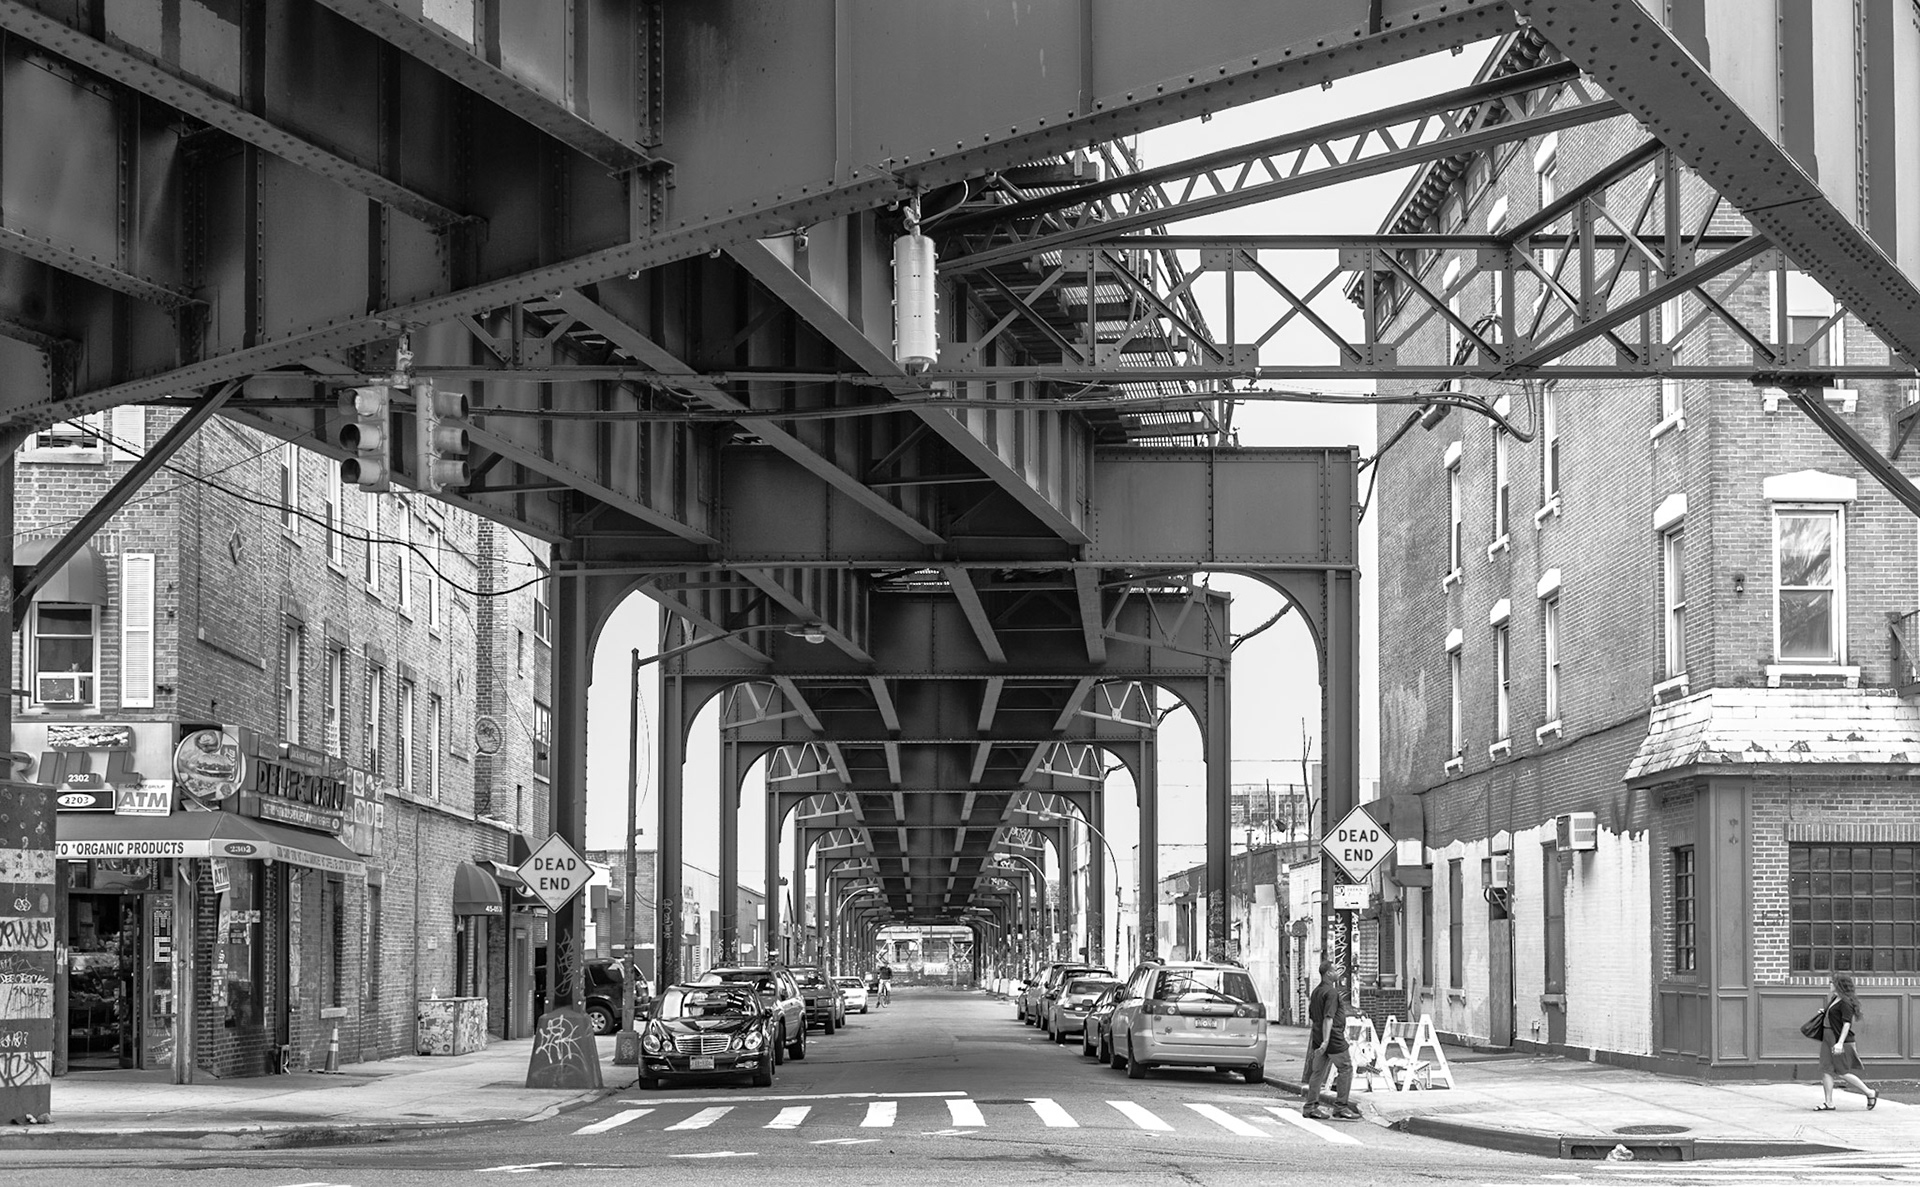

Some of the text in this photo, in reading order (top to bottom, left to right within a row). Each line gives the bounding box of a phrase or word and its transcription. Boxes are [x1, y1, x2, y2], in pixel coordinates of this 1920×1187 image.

[67, 774, 90, 783] 2302
[64, 796, 89, 804] 2203
[118, 791, 168, 808] ATM
[1338, 829, 1379, 843] DEAD
[127, 841, 184, 854] PRODUCTS
[229, 845, 252, 854] 2302
[1344, 848, 1373, 862] END
[534, 857, 577, 871] DEAD
[213, 867, 229, 885] ATM
[540, 877, 570, 890] END
